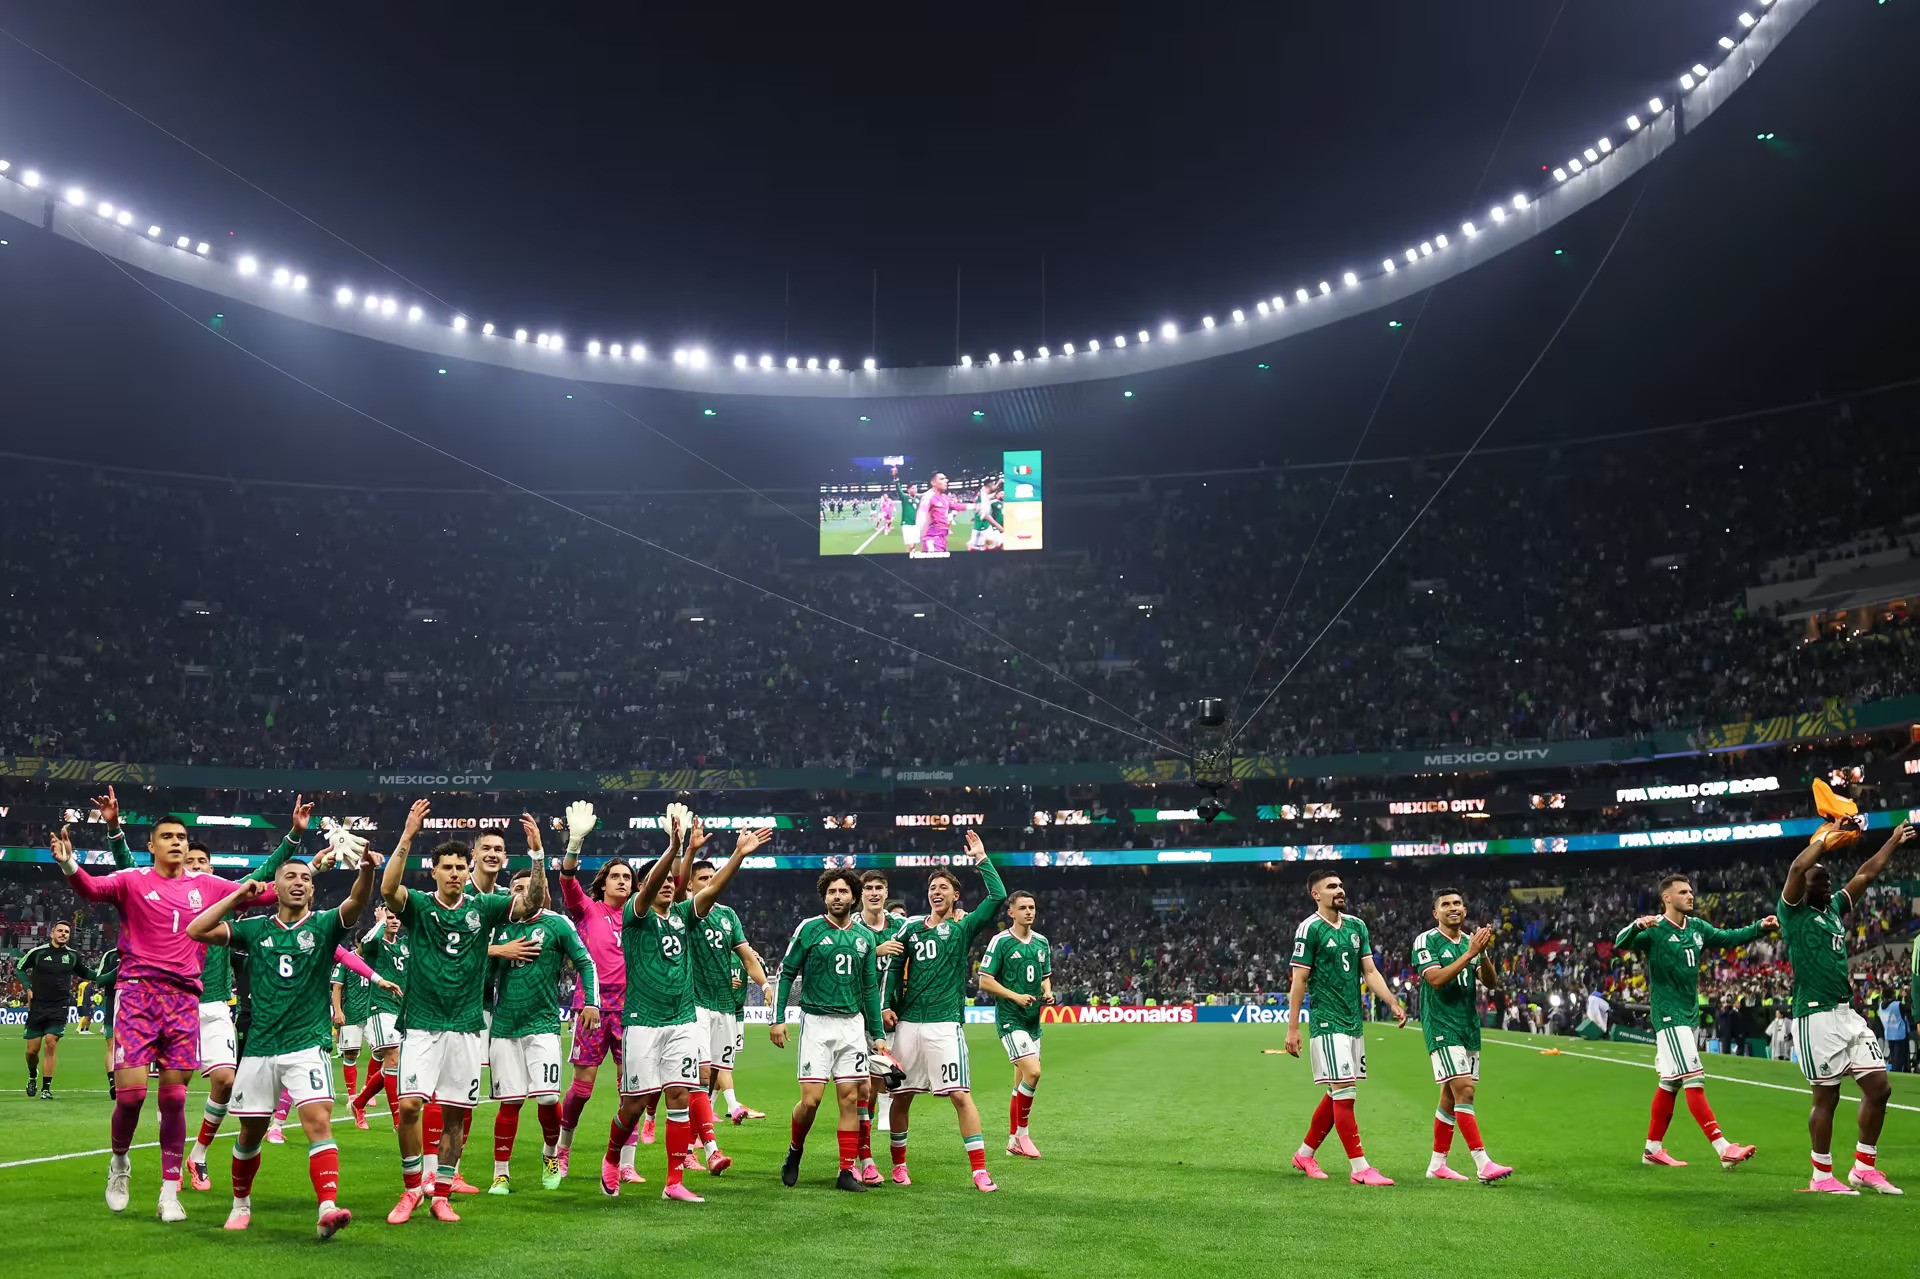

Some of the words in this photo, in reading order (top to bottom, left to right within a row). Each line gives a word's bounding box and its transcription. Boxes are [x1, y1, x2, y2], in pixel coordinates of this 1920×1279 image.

[1424, 751, 1500, 766] MEXICO
[1504, 748, 1550, 761] CITY
[379, 775, 449, 785] MEXICO
[452, 775, 493, 785] CITY
[1616, 787, 1648, 803] FIFA
[1647, 783, 1699, 800] WORLD
[1700, 781, 1729, 796] CUP
[1389, 800, 1448, 815] MEXICO
[1450, 799, 1486, 813] CITY
[423, 818, 477, 829] MEXICO
[479, 818, 511, 829] CITY
[629, 817, 657, 829] FIFA
[704, 816, 731, 829] CUP
[895, 814, 950, 826] MEXICO
[952, 814, 985, 826] CITY
[1619, 833, 1651, 848] FIFA
[1650, 829, 1704, 845] WORLD
[1702, 827, 1732, 842] CUP
[1391, 843, 1450, 857] MEXICO
[1452, 842, 1488, 855] CITY
[895, 855, 950, 867] MEXICO
[952, 854, 977, 867] CIT
[172, 910, 180, 933] 1
[446, 932, 460, 955] 2
[662, 935, 682, 957] 23
[704, 928, 723, 949] 22
[914, 939, 937, 961] 20
[1685, 948, 1695, 967] 11
[279, 954, 293, 978] 6
[393, 956, 404, 972] 15
[835, 953, 852, 975] 21
[1341, 952, 1350, 972] 5
[1026, 964, 1035, 983] 8
[0, 1007, 28, 1025] Rexo
[744, 1010, 772, 1020] ANK
[1079, 1006, 1194, 1023] McDonald's
[1246, 1004, 1310, 1024] Rexn
[543, 1063, 559, 1084] 10
[681, 1057, 698, 1078] 23
[941, 1062, 959, 1084] 20
[309, 1068, 323, 1091] 6
[468, 1078, 479, 1101] 2
